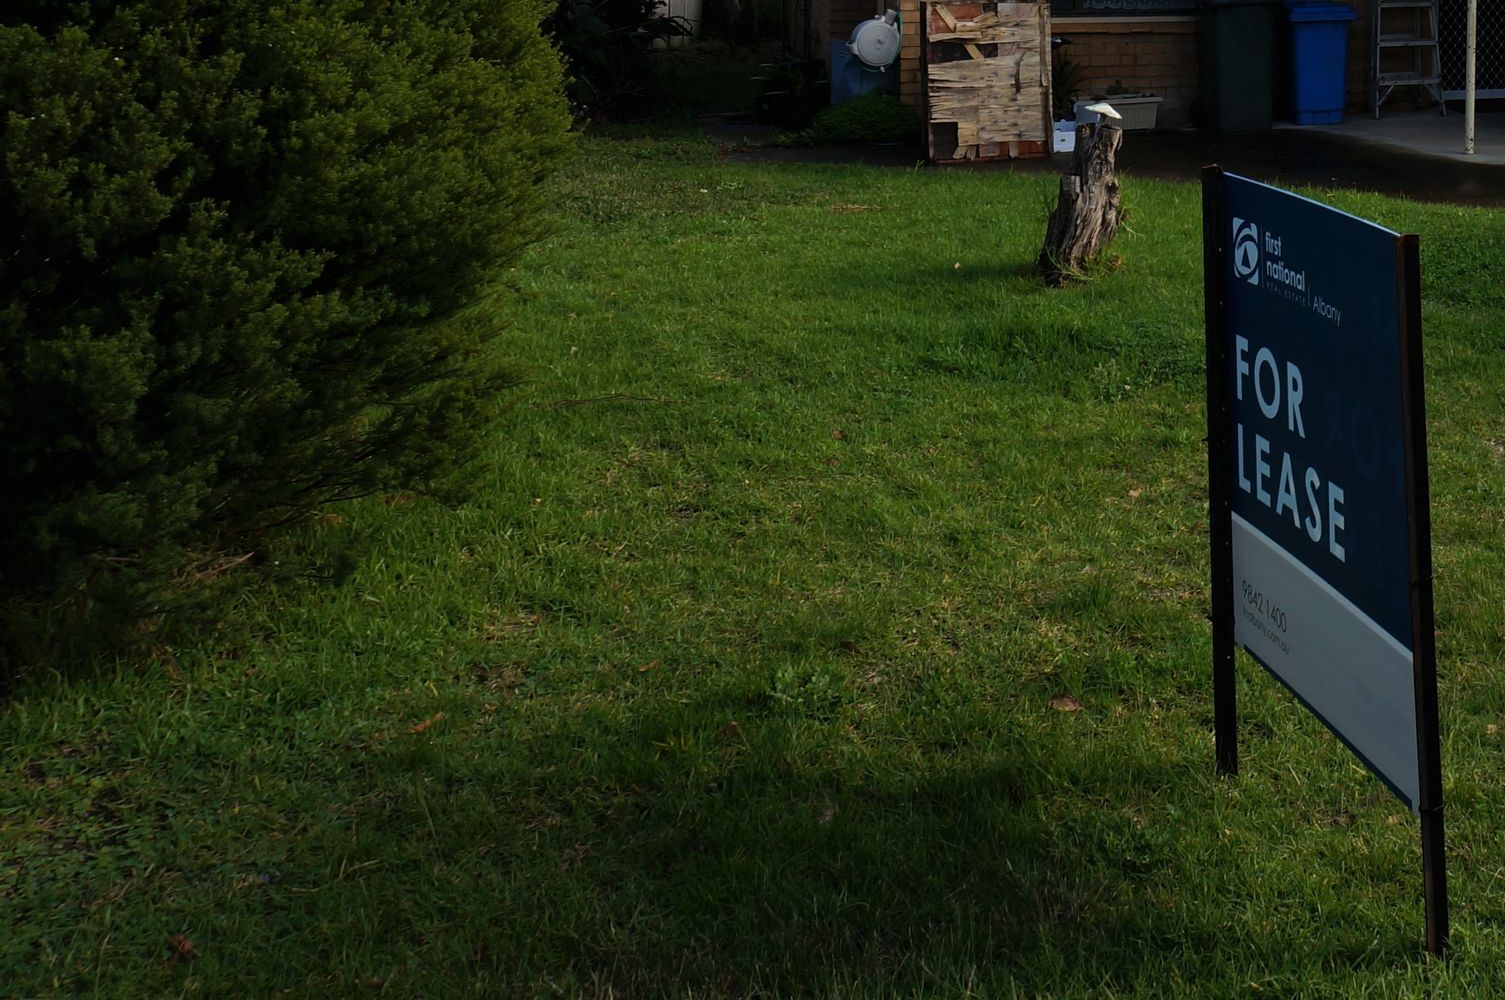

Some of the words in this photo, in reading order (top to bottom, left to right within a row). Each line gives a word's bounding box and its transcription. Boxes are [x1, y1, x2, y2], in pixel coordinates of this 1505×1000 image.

[1265, 231, 1282, 257] first
[1266, 260, 1305, 292] national
[1313, 295, 1341, 327] Albany
[1236, 334, 1305, 439] FOR
[1237, 423, 1346, 563] LEASE
[1242, 579, 1263, 614] 9842
[1266, 599, 1287, 633] 1400
